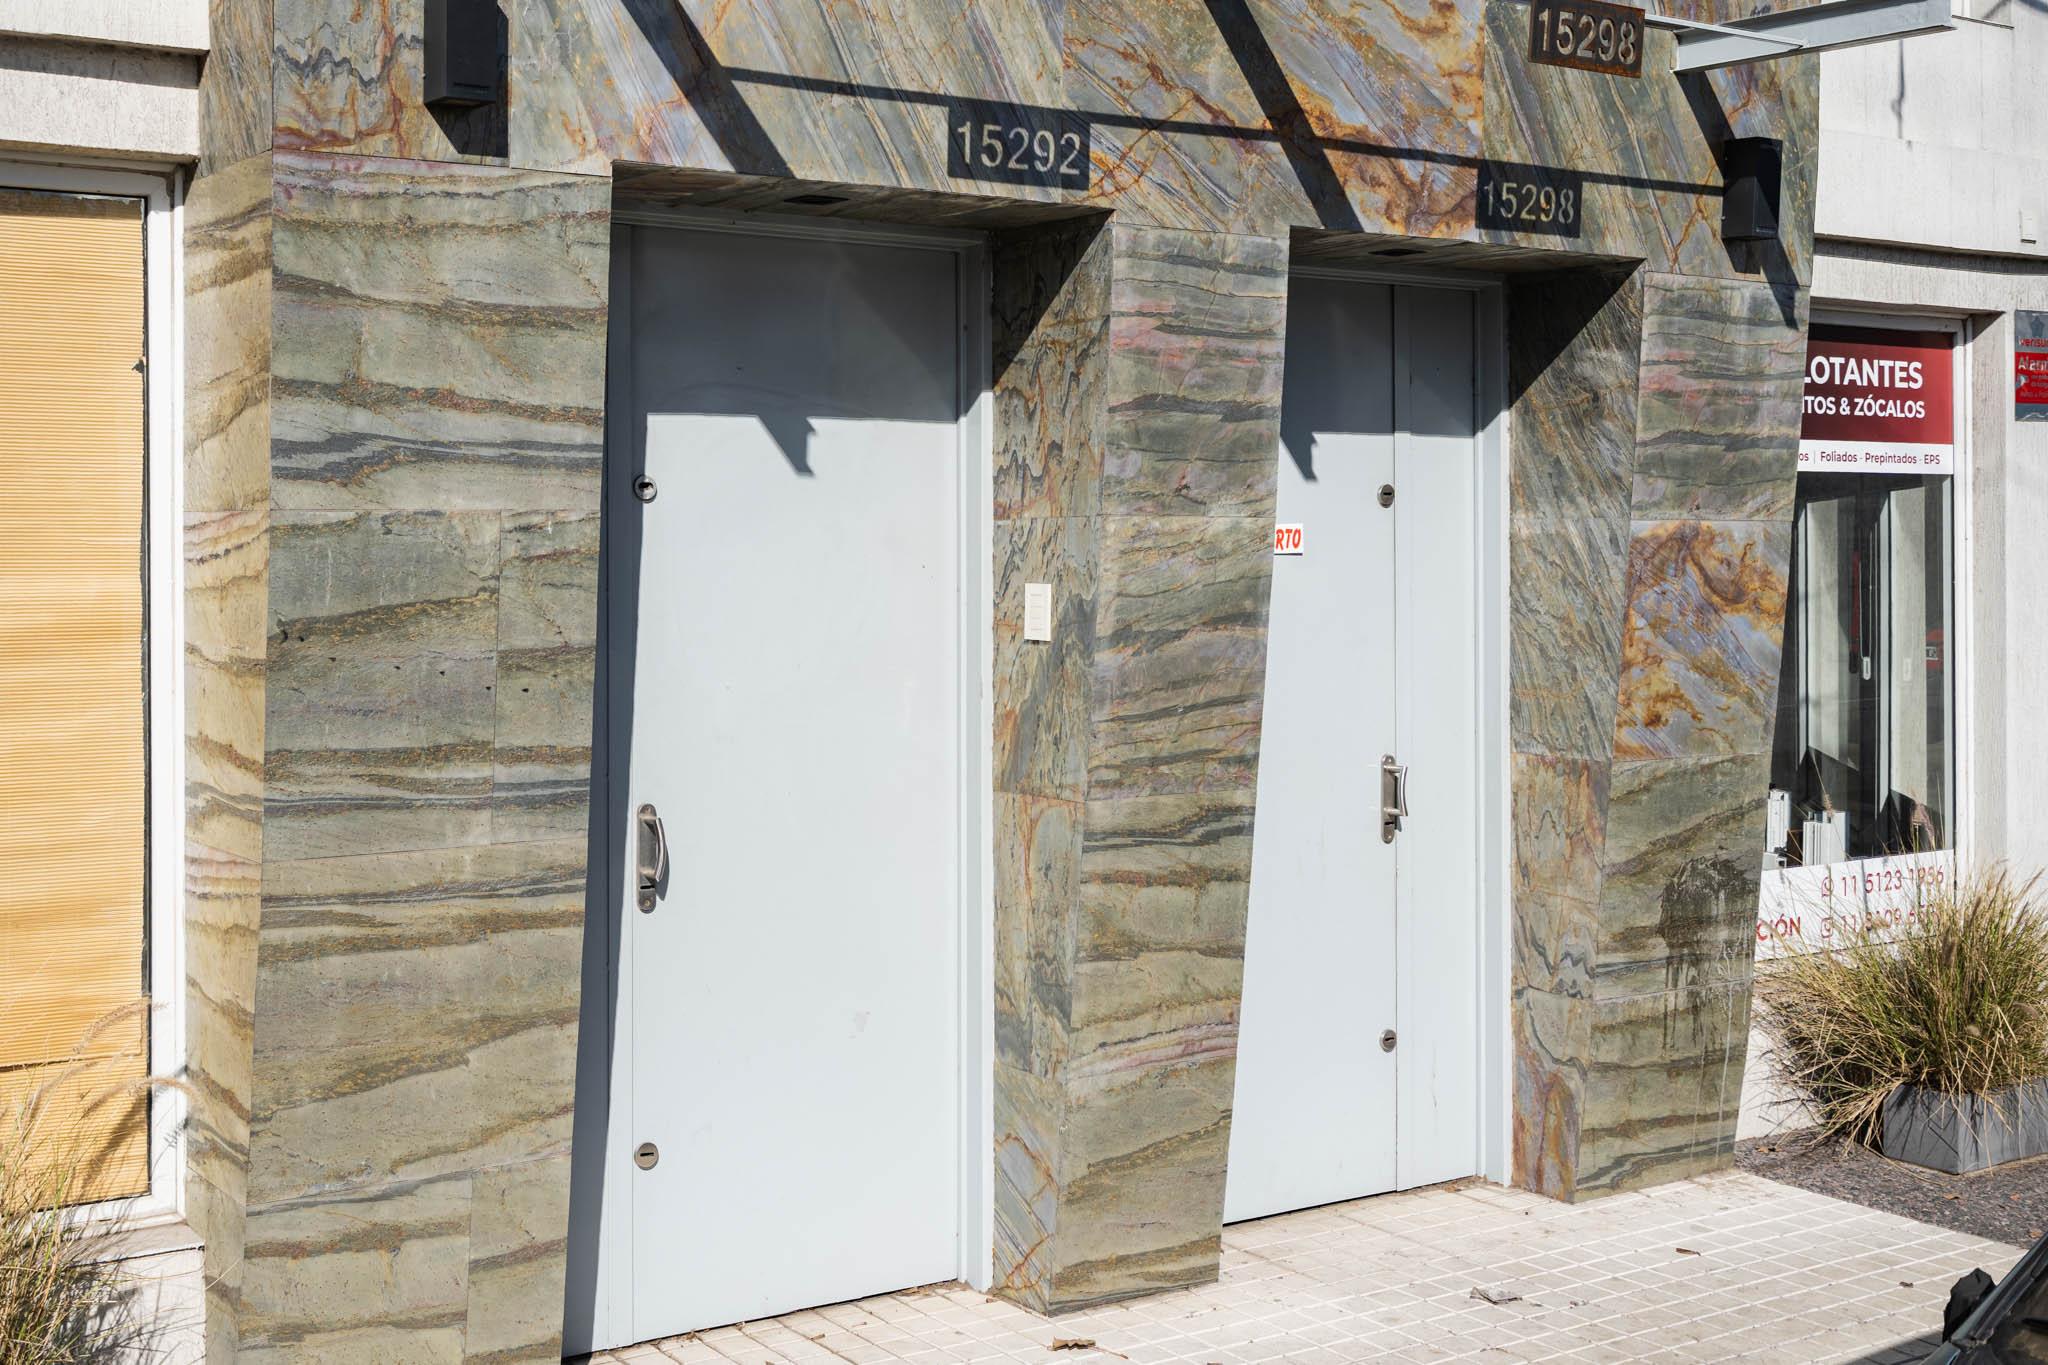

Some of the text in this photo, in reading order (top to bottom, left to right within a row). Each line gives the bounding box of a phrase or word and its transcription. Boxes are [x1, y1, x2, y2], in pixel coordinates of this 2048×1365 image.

[1538, 8, 1636, 65] 15298
[957, 121, 1081, 175] 15292
[1484, 180, 1574, 224] 15298
[1802, 394, 1925, 419] TOS & ZÓCALOS
[1820, 451, 1858, 463] Foliados
[1865, 452, 1917, 465] Prepintados
[1924, 454, 1940, 464] EPS
[1276, 528, 1301, 550] RTO
[1842, 875, 1857, 896] 11
[1865, 870, 1902, 893] 5123
